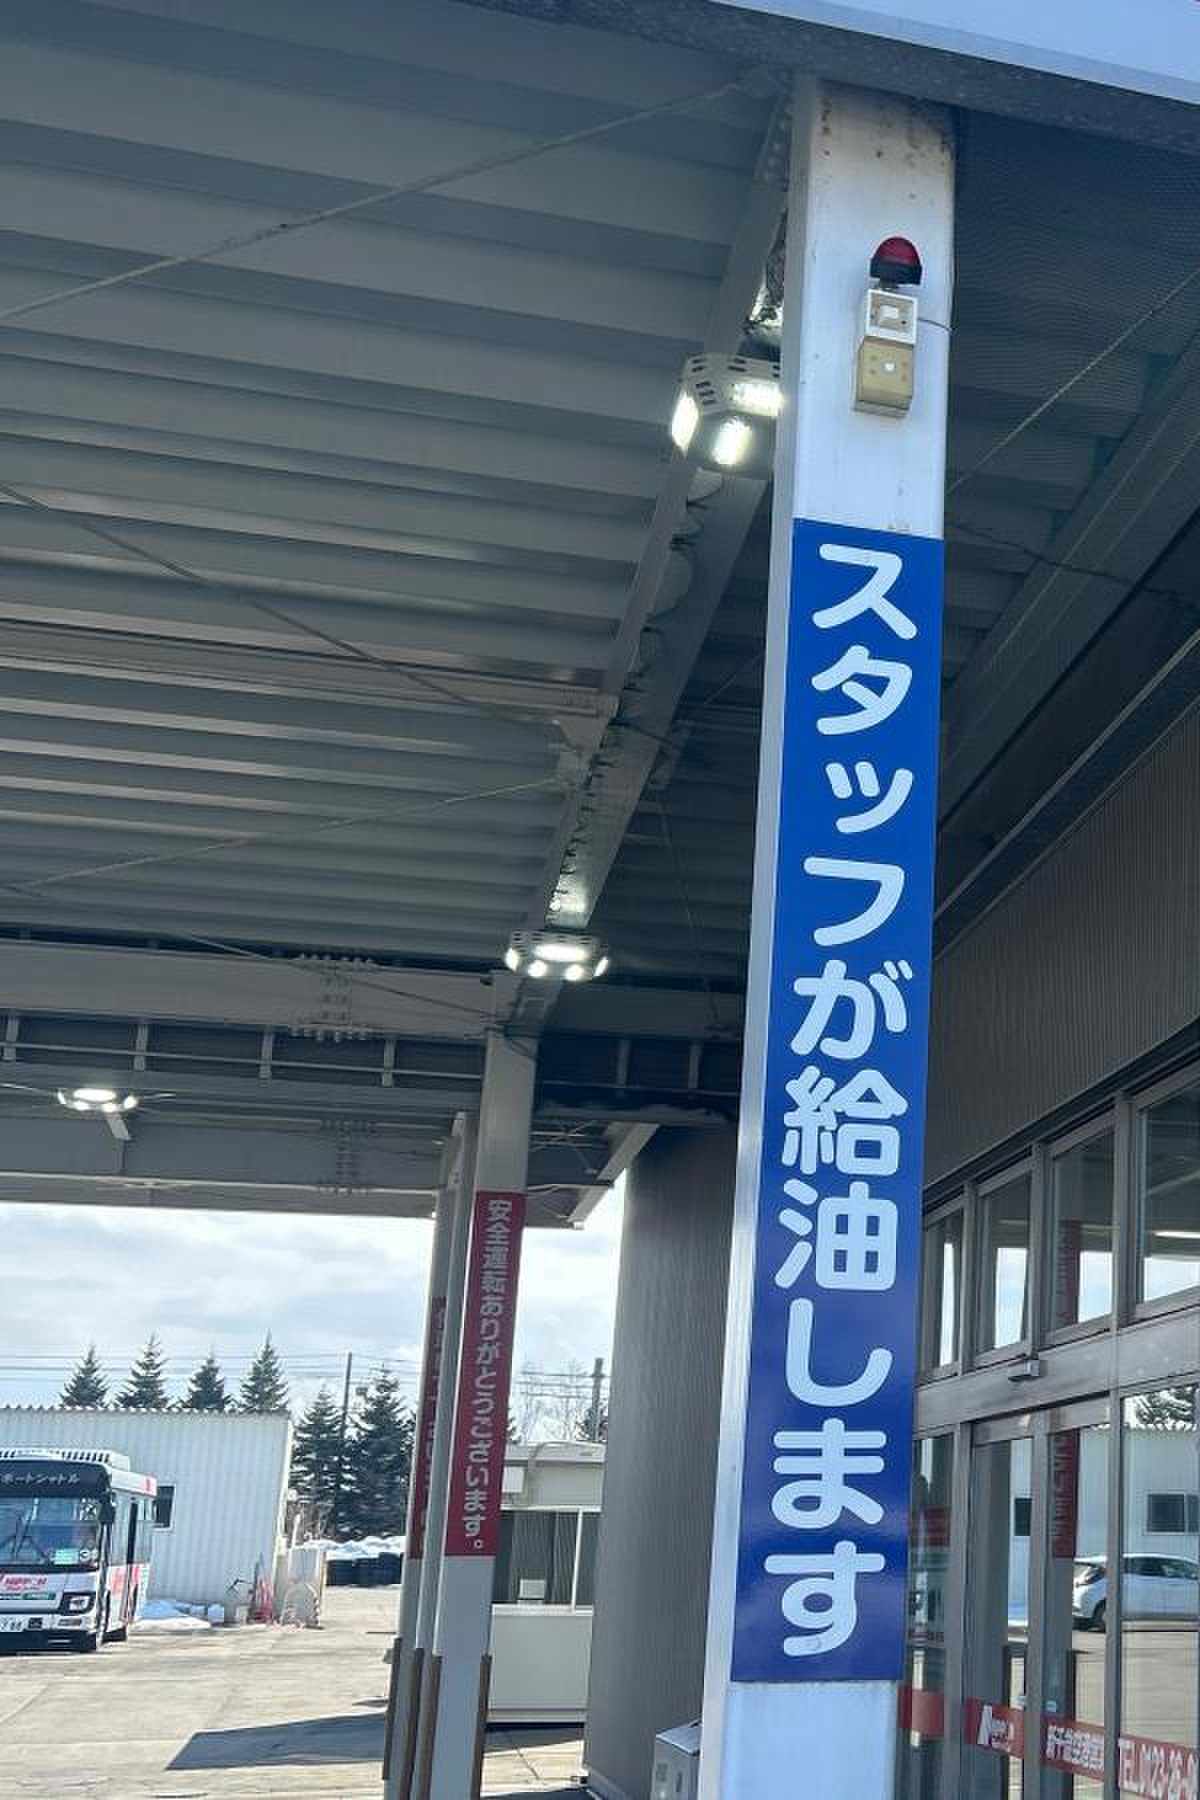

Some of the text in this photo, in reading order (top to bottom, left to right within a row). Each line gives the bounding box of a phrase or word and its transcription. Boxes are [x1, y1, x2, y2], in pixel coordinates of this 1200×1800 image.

[763, 543, 918, 1658] スタッフが給油します
